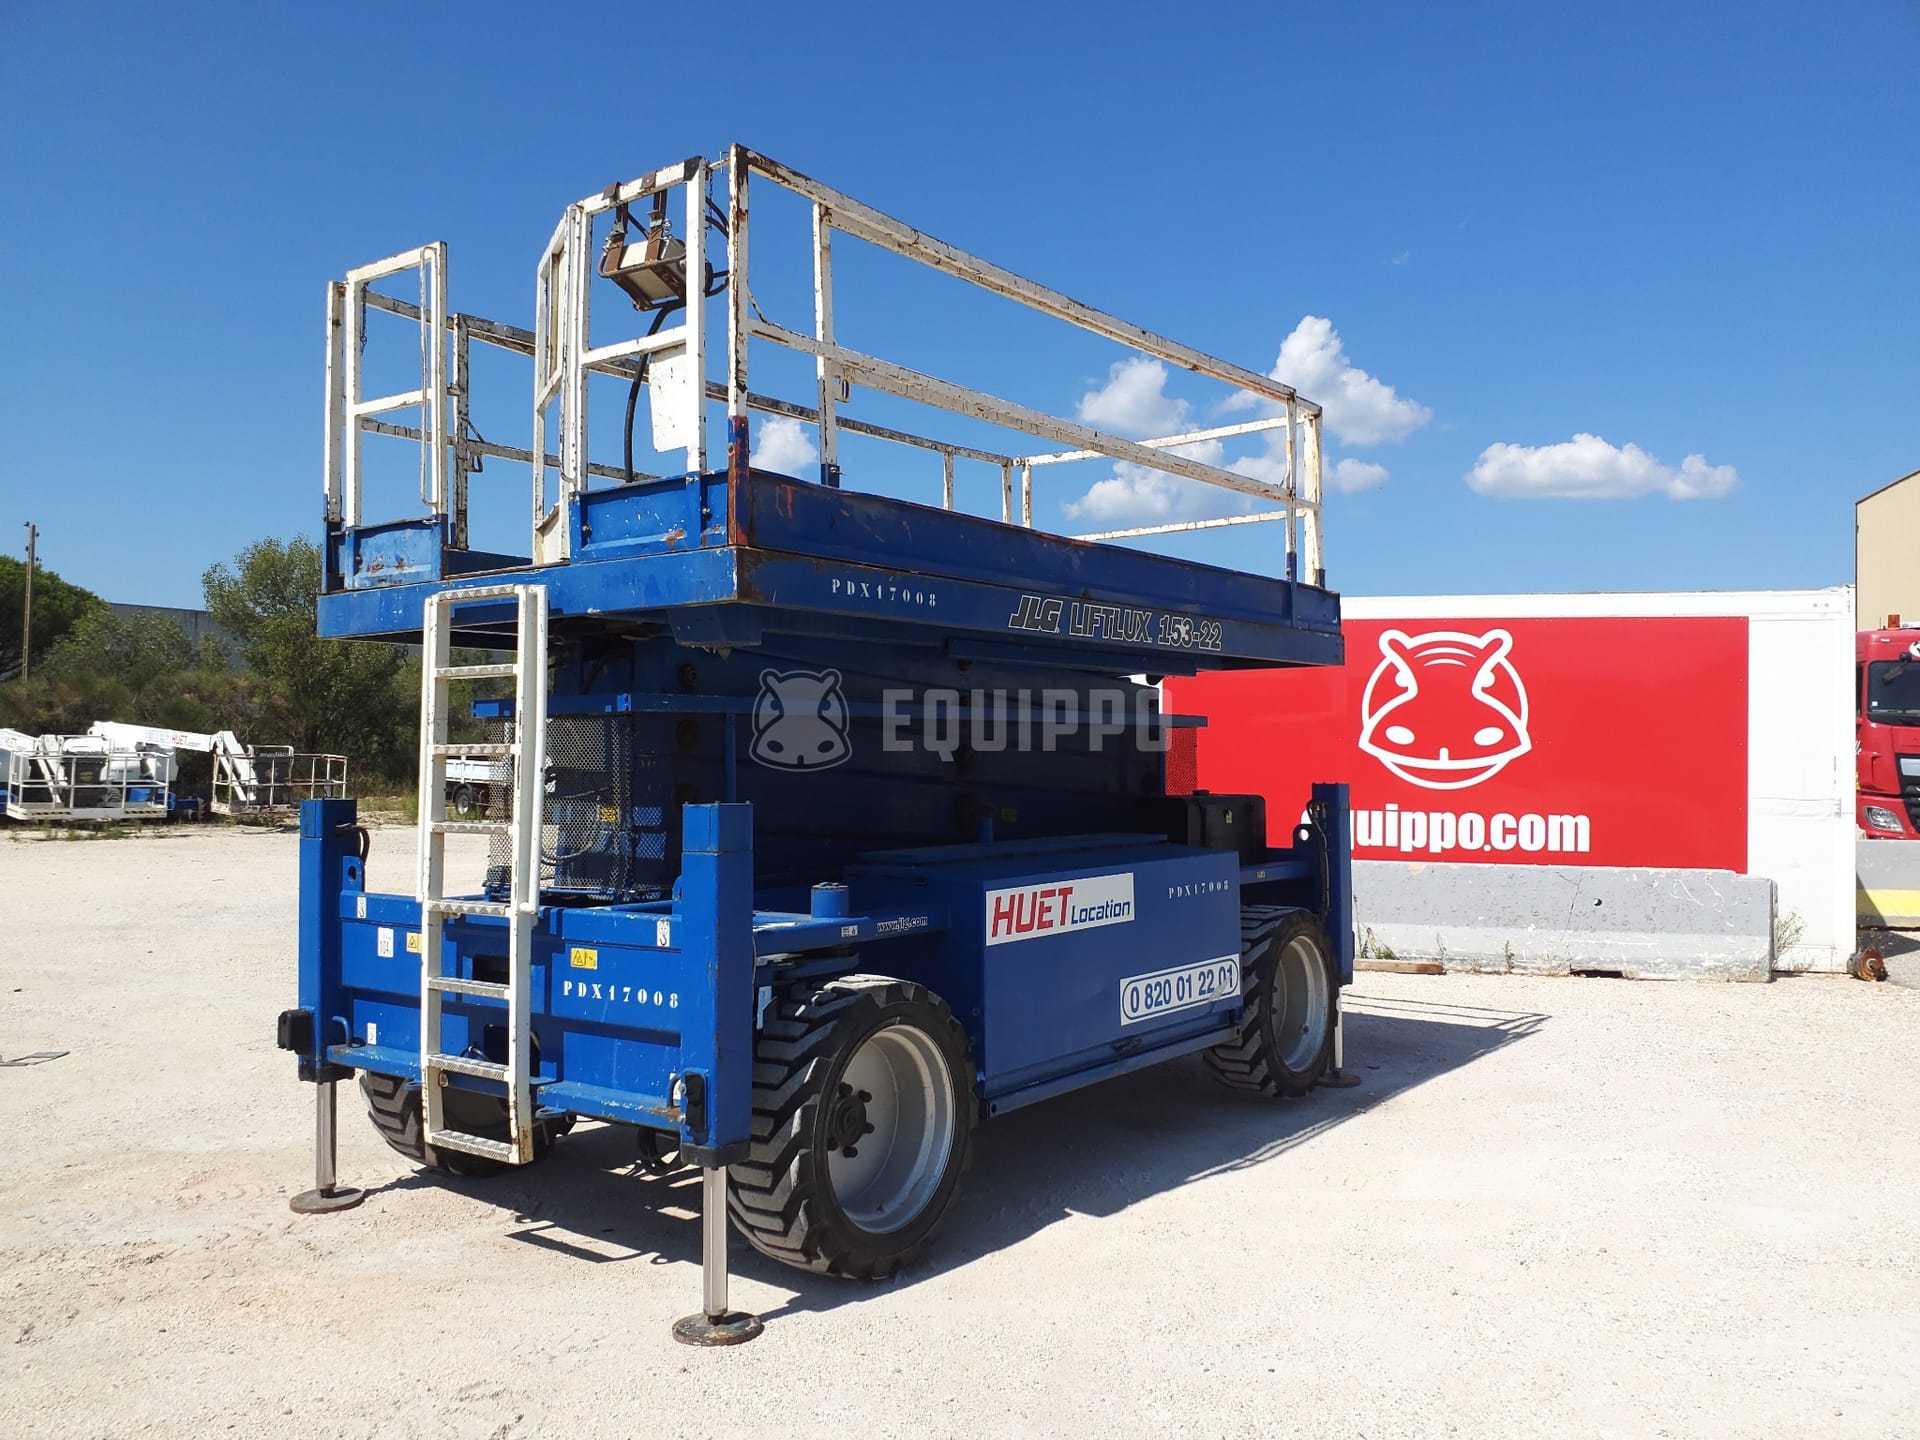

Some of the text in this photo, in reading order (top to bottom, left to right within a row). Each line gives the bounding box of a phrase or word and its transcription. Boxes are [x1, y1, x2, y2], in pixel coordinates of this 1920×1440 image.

[831, 578, 936, 607] PDX17008
[1008, 595, 1222, 650] JLG LIFTLUX 153-22
[1301, 803, 1590, 853] uippo.com
[1168, 879, 1230, 899] PDX17008
[877, 916, 928, 932] www.jlg.com
[991, 886, 1130, 937] HUET Location
[563, 980, 678, 1008] PDX17008
[1130, 986, 1139, 1012] 0
[1144, 979, 1172, 1009] 820
[1176, 974, 1193, 1002] 01
[1198, 968, 1215, 995] 22
